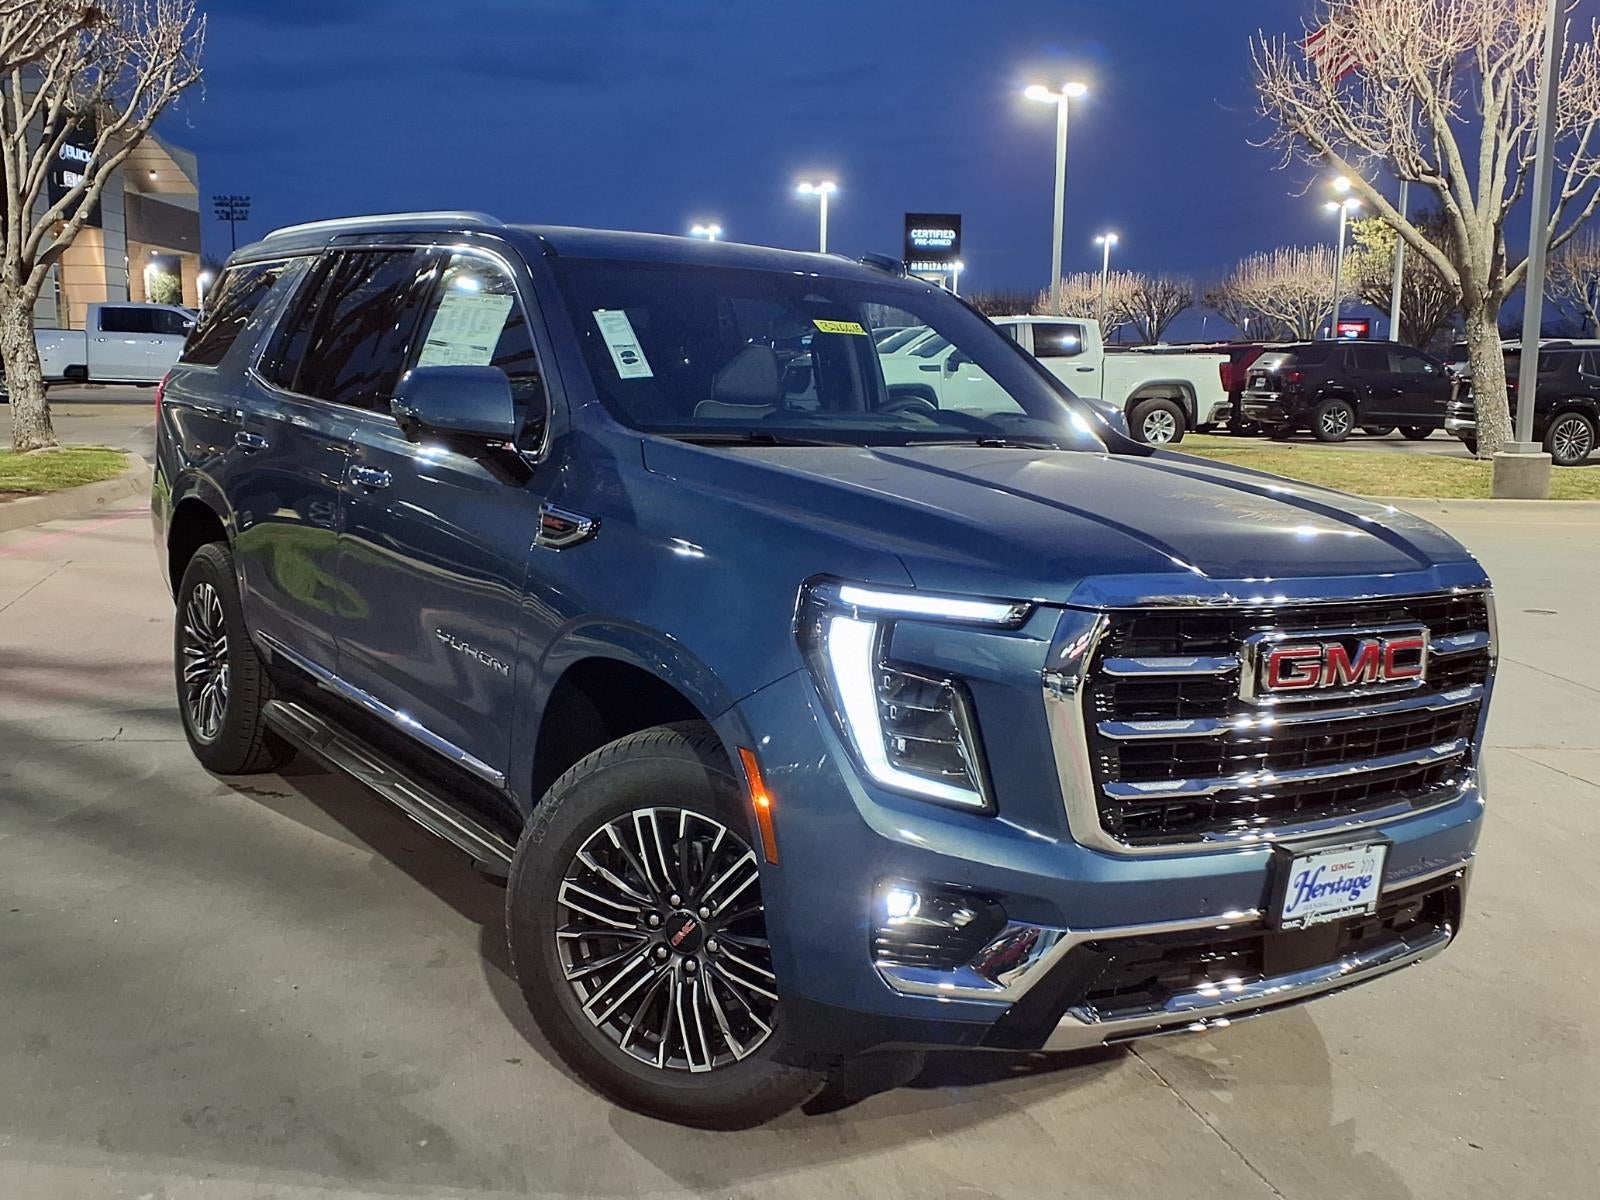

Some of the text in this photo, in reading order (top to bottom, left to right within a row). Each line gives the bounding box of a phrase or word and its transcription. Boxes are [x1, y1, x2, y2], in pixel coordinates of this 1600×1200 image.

[911, 229, 956, 239] CERTIFIED
[914, 238, 952, 246] PRE-OWNED
[436, 629, 510, 677] YUKON
[1264, 637, 1425, 690] GMC
[1331, 861, 1356, 872] GMC
[1286, 865, 1373, 913] Heritage
[671, 918, 697, 946] GMC
